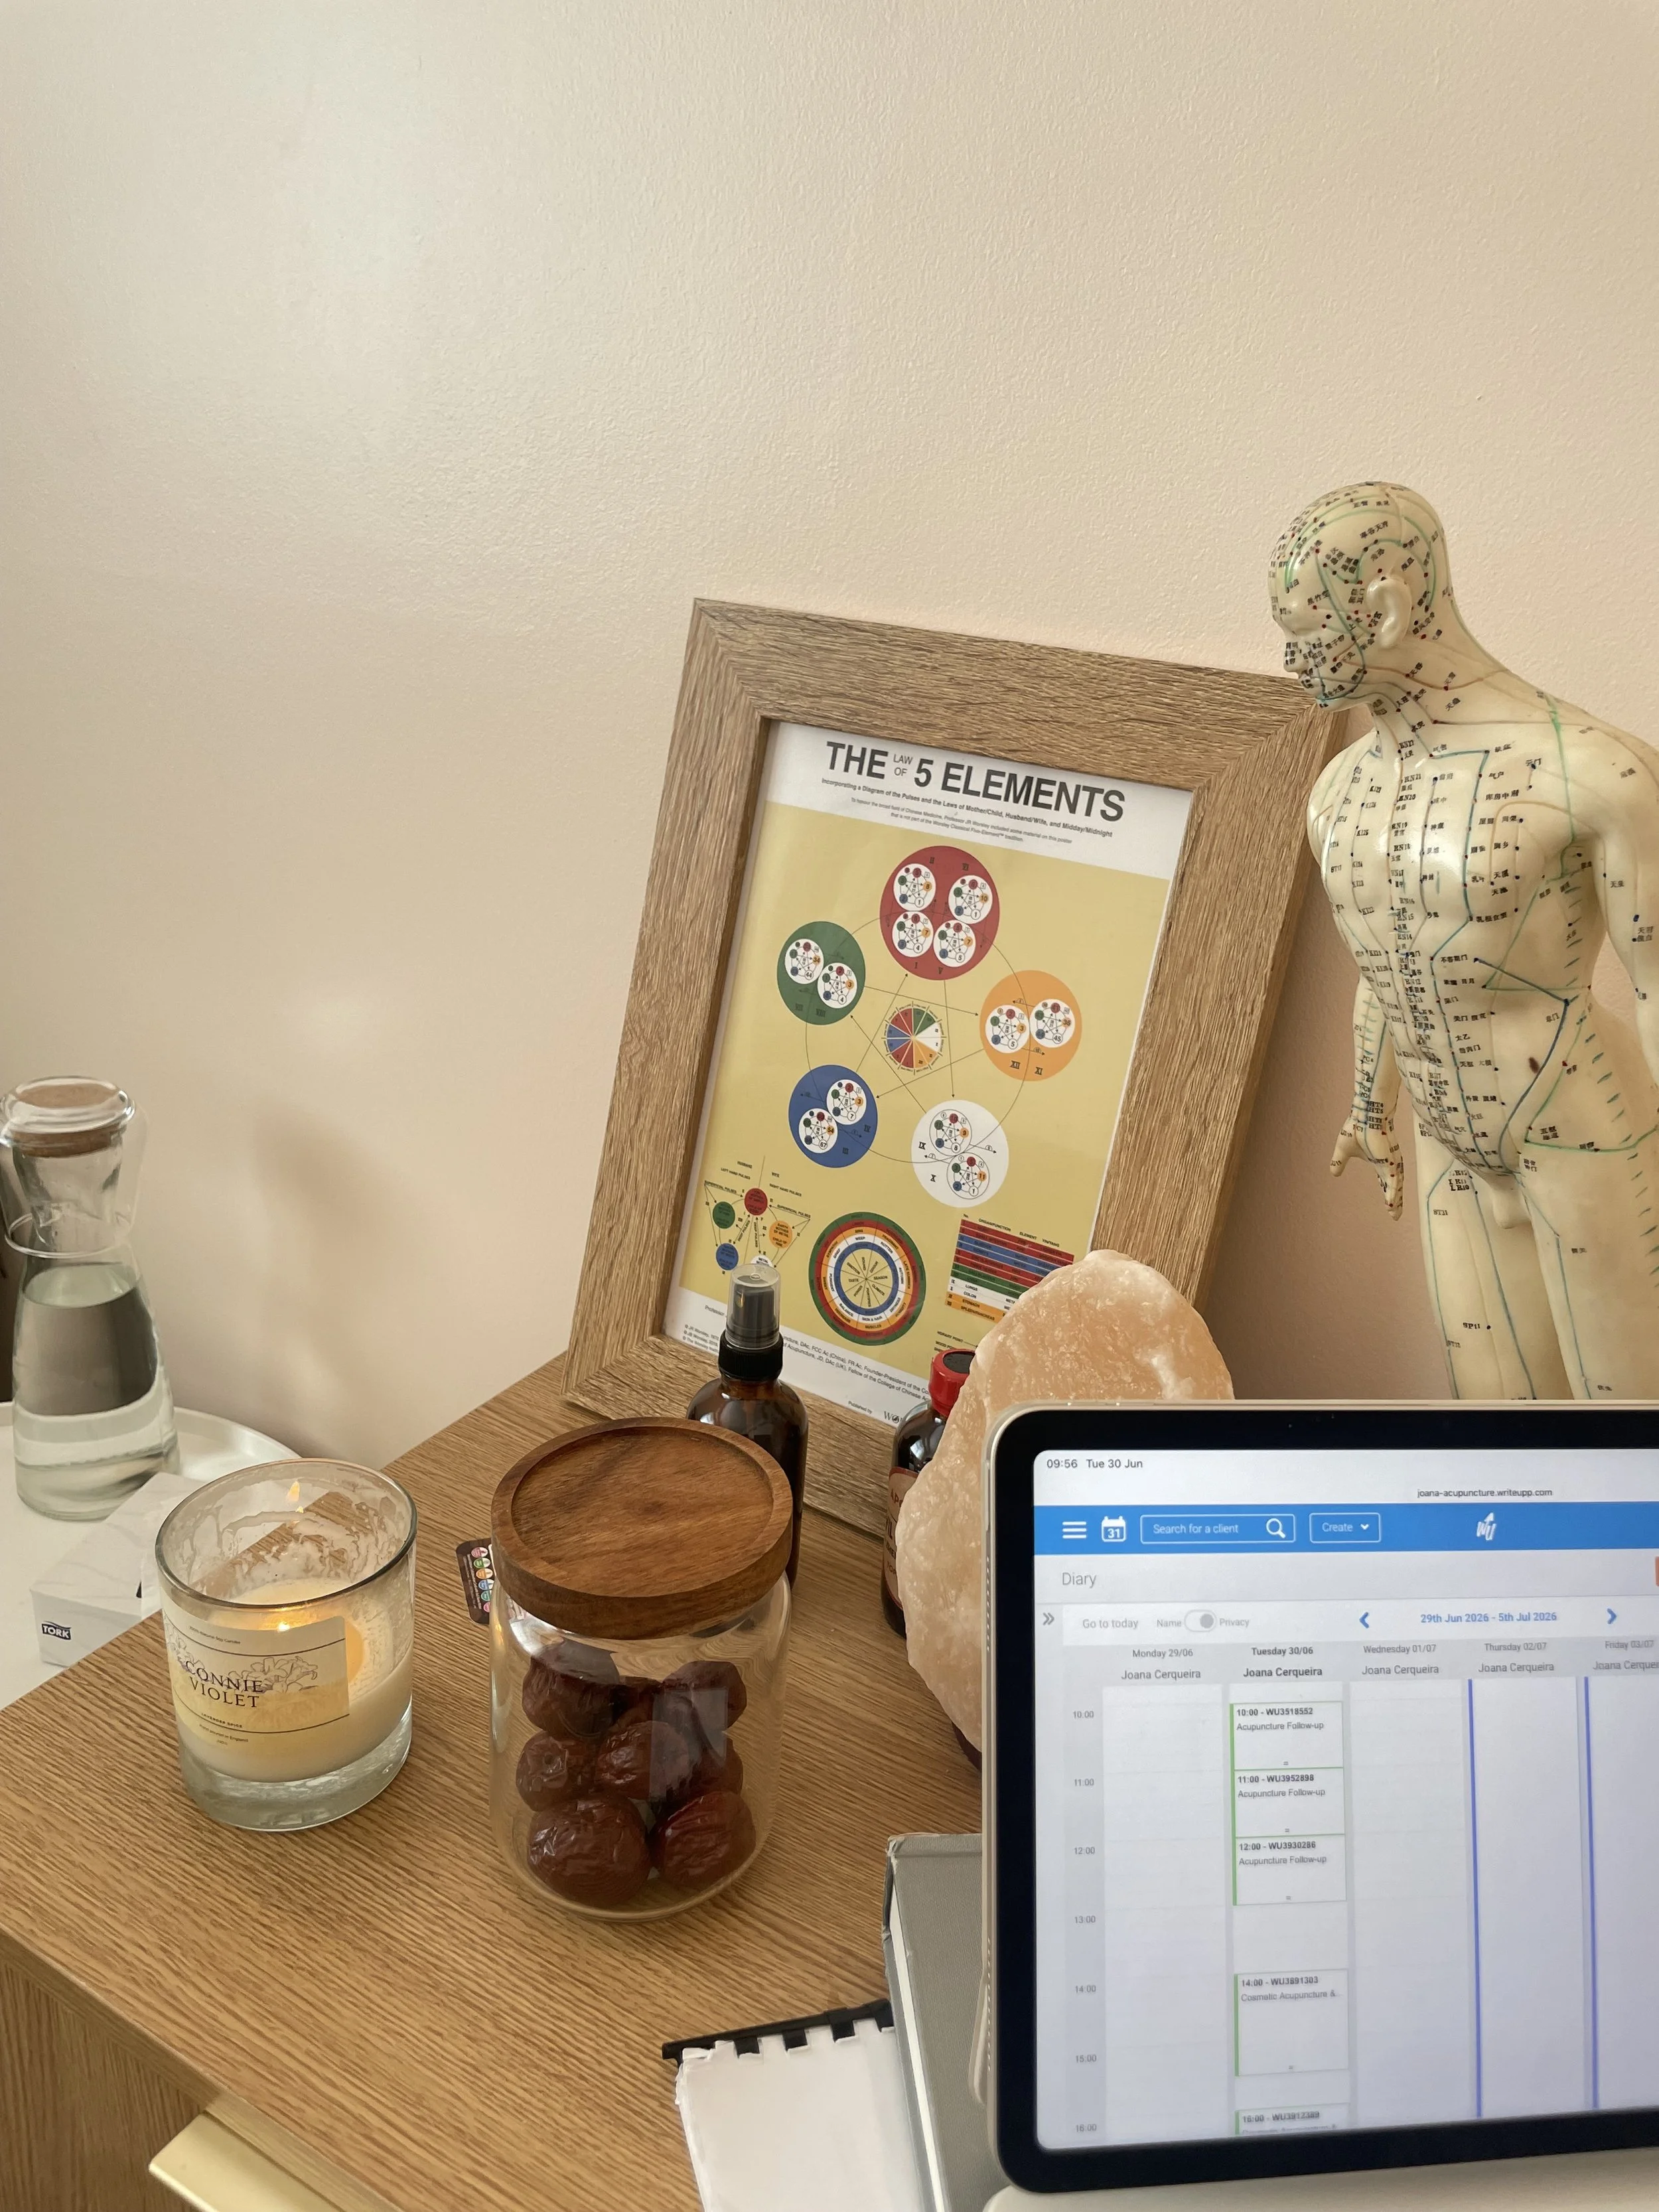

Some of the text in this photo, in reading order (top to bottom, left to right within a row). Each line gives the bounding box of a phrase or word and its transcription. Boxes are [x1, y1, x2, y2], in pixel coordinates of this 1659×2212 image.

[826, 741, 1125, 822] THE LAW OF 5 ELEMENTS
[821, 778, 857, 790] Incorporating
[861, 785, 884, 795] Diagram
[901, 793, 920, 802] Pulses
[965, 804, 1004, 818] Mother/Child,
[1005, 812, 1048, 826] Husband/Wife,
[1061, 822, 1112, 838] Midday/Midnight
[1455, 1033, 1471, 1042] 太乙
[1010, 1060, 1021, 1070] XII
[1035, 1067, 1043, 1075] XI
[918, 1142, 926, 1150] IX
[847, 1366, 863, 1376] Fellow
[876, 1378, 895, 1390] College
[901, 1387, 921, 1398] Chinese
[847, 1400, 867, 1412] Published
[1046, 1459, 1143, 1469] 09:56 Tue 30 Jun
[1417, 1489, 1553, 1499] joana-acupuncture.writeupp.com
[1153, 1523, 1187, 1534] Search
[1189, 1523, 1202, 1534] for
[1212, 1523, 1238, 1534] client
[1322, 1522, 1353, 1532] Create
[1107, 1527, 1121, 1539] 31
[1062, 1572, 1096, 1588] Diary
[1220, 1617, 1250, 1628] Privacy
[1420, 1613, 1442, 1623] 29th
[1445, 1613, 1462, 1623] Jun
[1465, 1613, 1489, 1623] 2026
[1498, 1612, 1514, 1623] 5th
[1516, 1612, 1531, 1622] Jul
[1534, 1611, 1557, 1622] 2026
[1082, 1617, 1139, 1630] Go to today
[1157, 1618, 1182, 1628] Name
[42, 1626, 70, 1639] TORK
[1363, 1643, 1437, 1655] Wednesday 01/07
[1484, 1641, 1547, 1653] Thursday 02/07
[1605, 1639, 1654, 1651] Friday 03/07
[1132, 1647, 1193, 1659] Monday 29/06
[1252, 1646, 1313, 1657] Tuesday 30/06
[1362, 1664, 1439, 1676] Joana Cerqueira
[1478, 1662, 1555, 1674] Joana Cerqueira
[1593, 1660, 1621, 1670] Joana
[185, 1660, 263, 1693] CONNIE
[1121, 1668, 1201, 1680] Joana Cerqueira
[1243, 1666, 1323, 1678] Joana Cerqueira
[189, 1676, 259, 1708] VIOLET
[1072, 1710, 1094, 1719] 10:00
[1236, 1708, 1259, 1717] 10:00
[1265, 1707, 1313, 1716] WU3518552
[1236, 1721, 1325, 1732] Acupuncture Follow-up
[1074, 1778, 1094, 1787] 11:00
[1237, 1775, 1260, 1783] 11:00
[1266, 1773, 1315, 1783] WU3952898
[1238, 1788, 1326, 1799] Acupuncture Follow-up
[1074, 1846, 1096, 1855] 12:00
[1239, 1842, 1261, 1851] 12:00
[1267, 1840, 1316, 1850] WU3930286
[1238, 1855, 1327, 1866] Acupuncture Follow-up
[1074, 1915, 1096, 1924] 13:00
[1074, 1984, 1096, 1993] 14:00
[1241, 1978, 1263, 1988] 14:00
[1279, 1990, 1327, 2001] Acupuncture
[1075, 2054, 1097, 2063] 15:00
[1242, 2114, 1264, 2123] 16:00
[1075, 2123, 1097, 2132] 16:00
